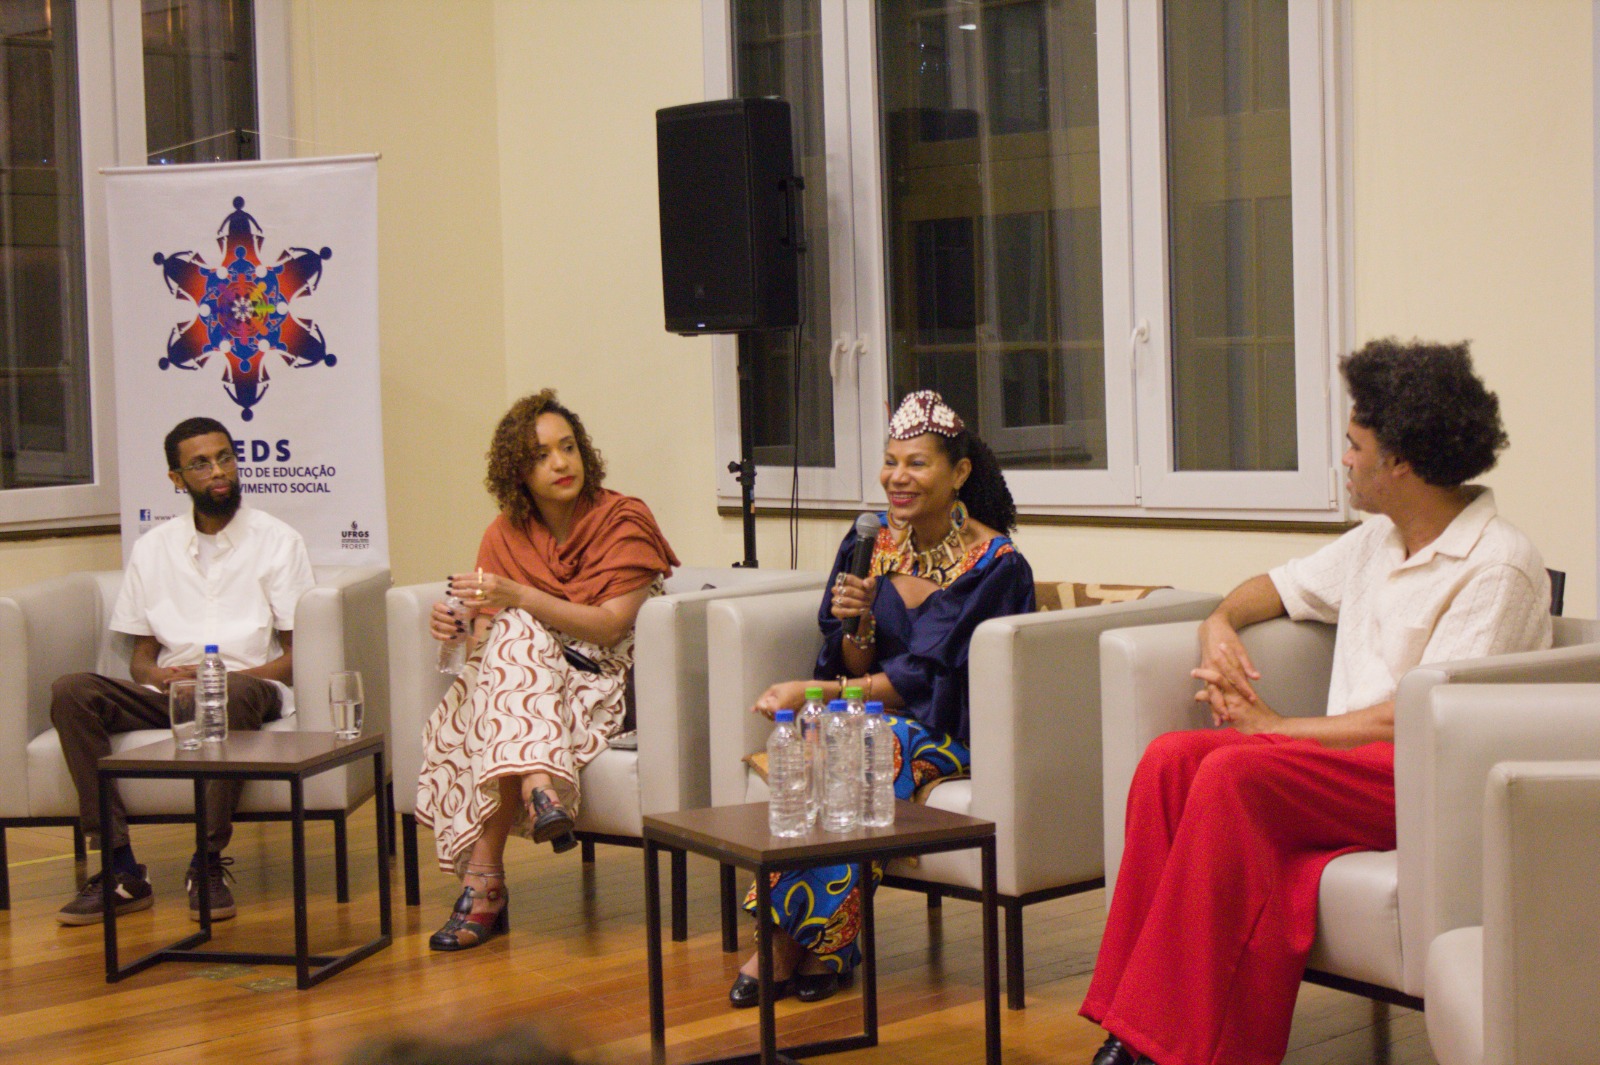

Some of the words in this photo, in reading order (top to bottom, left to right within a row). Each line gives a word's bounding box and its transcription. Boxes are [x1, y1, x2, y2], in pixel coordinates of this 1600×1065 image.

[232, 439, 291, 462] EDS
[255, 467, 271, 477] DE
[273, 465, 336, 479] EDUCAÇÃO
[290, 482, 331, 493] SOCIAL
